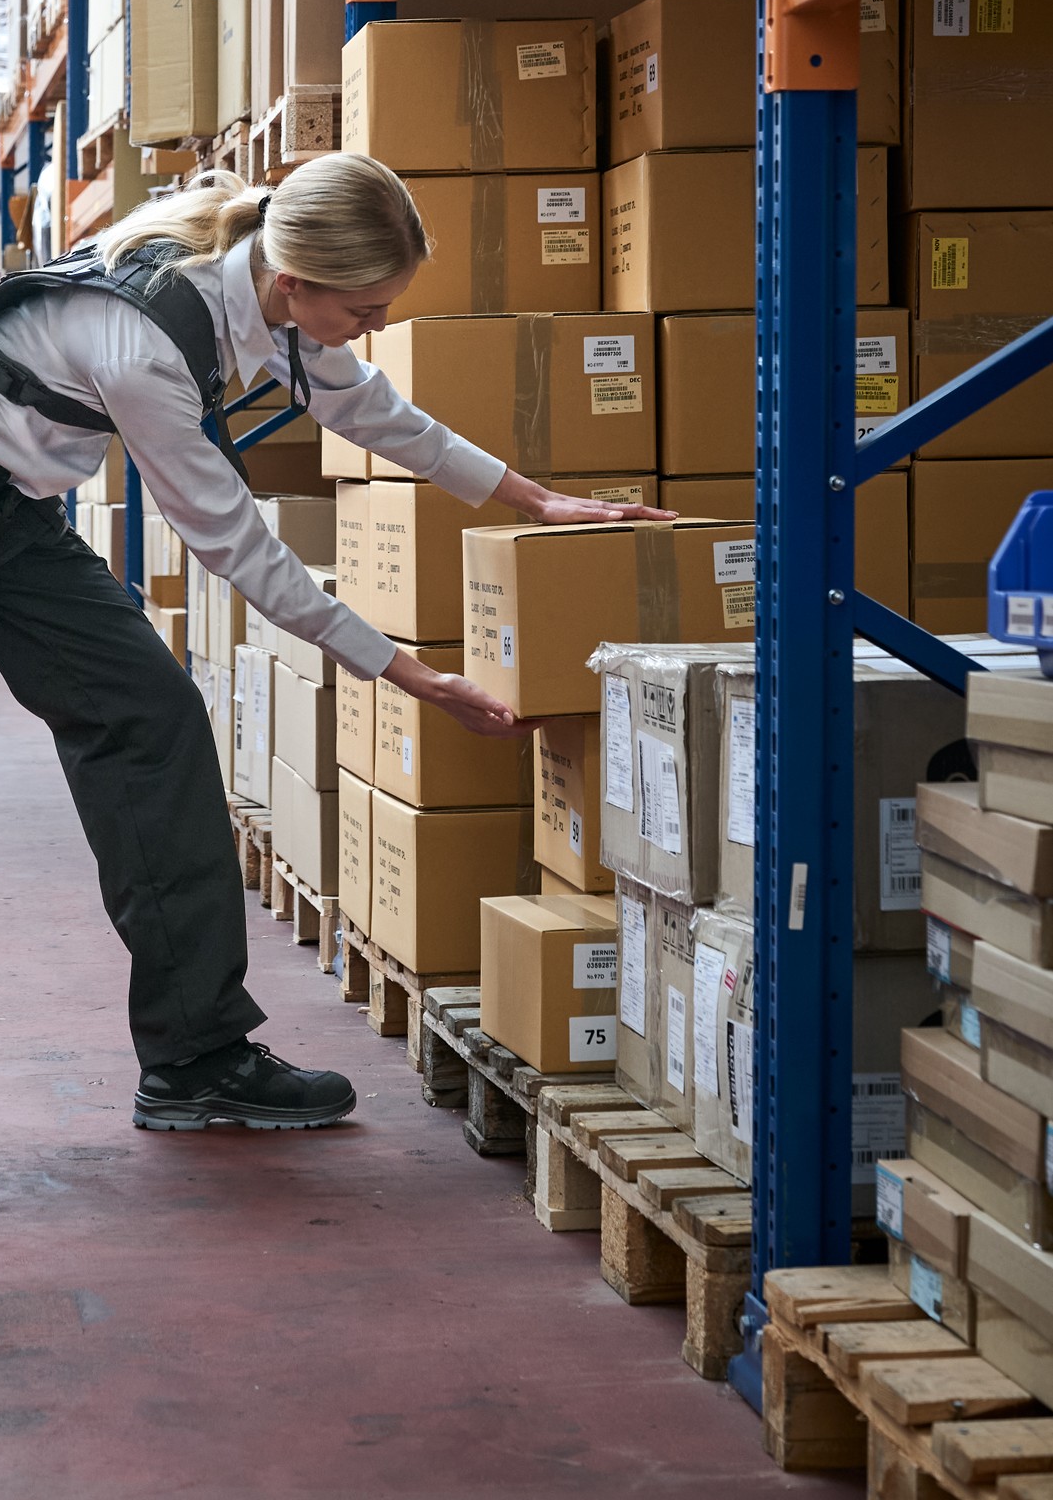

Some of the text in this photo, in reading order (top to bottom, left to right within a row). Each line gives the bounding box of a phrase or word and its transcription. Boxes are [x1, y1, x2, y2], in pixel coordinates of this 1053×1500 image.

[504, 636, 512, 656] 66
[573, 820, 579, 843] 59
[584, 1028, 606, 1046] 75
